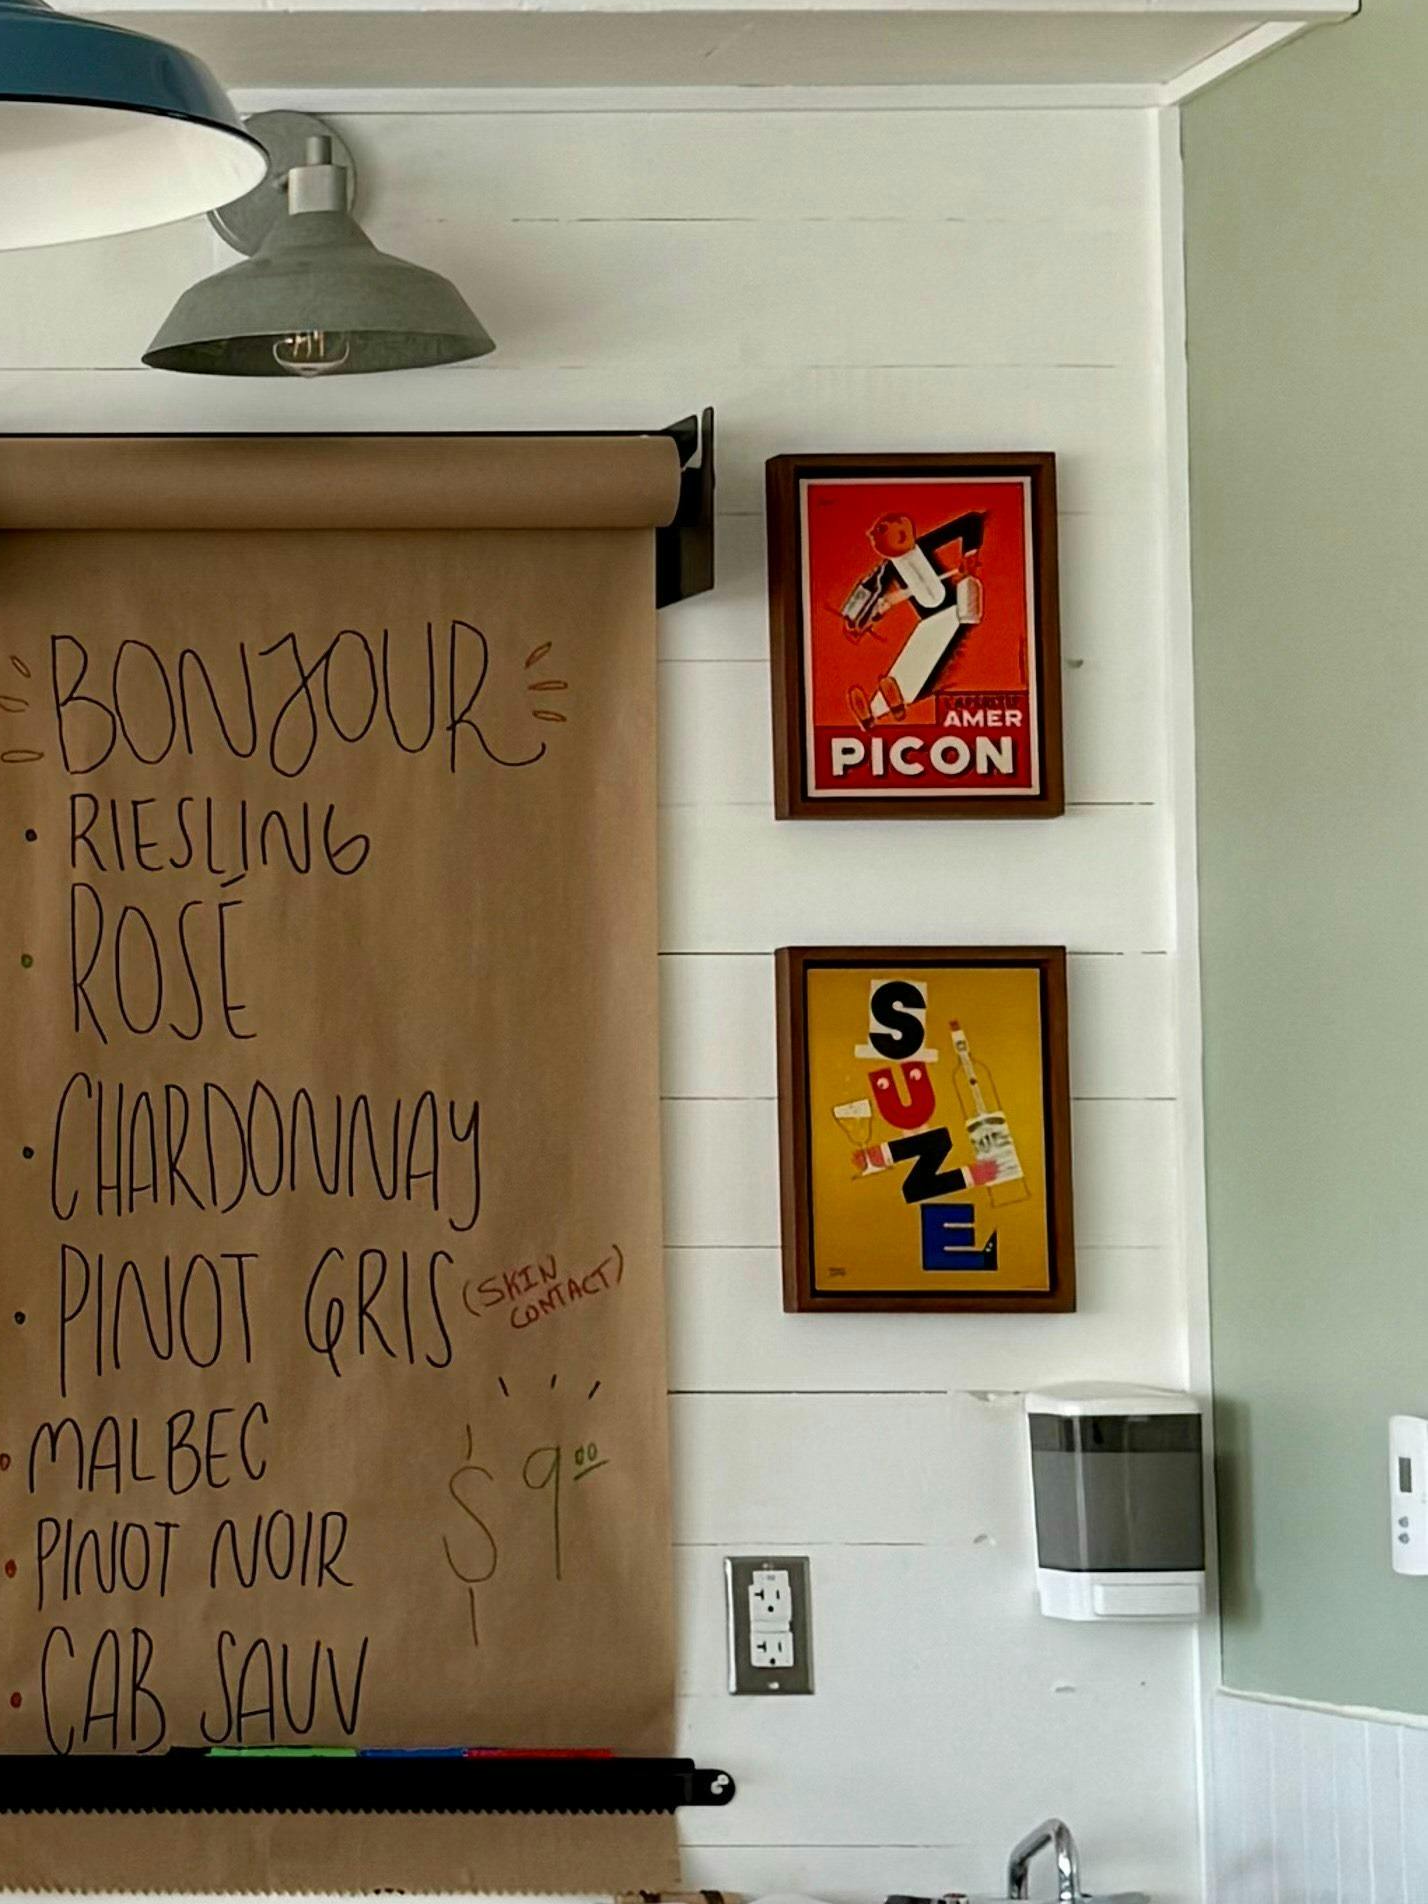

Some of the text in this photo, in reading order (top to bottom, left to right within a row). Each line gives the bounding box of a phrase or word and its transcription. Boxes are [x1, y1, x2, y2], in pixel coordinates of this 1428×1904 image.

[50, 619, 546, 778] BONJOUR
[830, 734, 1015, 777] PICON
[943, 708, 1023, 728] AMER
[69, 792, 371, 876] RIESLING
[50, 1071, 482, 1233] CHARDONNAY
[868, 980, 998, 1272] SUZE
[59, 1243, 260, 1397] PINOT
[304, 1247, 455, 1377] GRIS
[27, 1401, 270, 1496] MALBEC
[36, 1509, 354, 1611] PINOT NOIR
[40, 1625, 369, 1756] CAB SAUV
